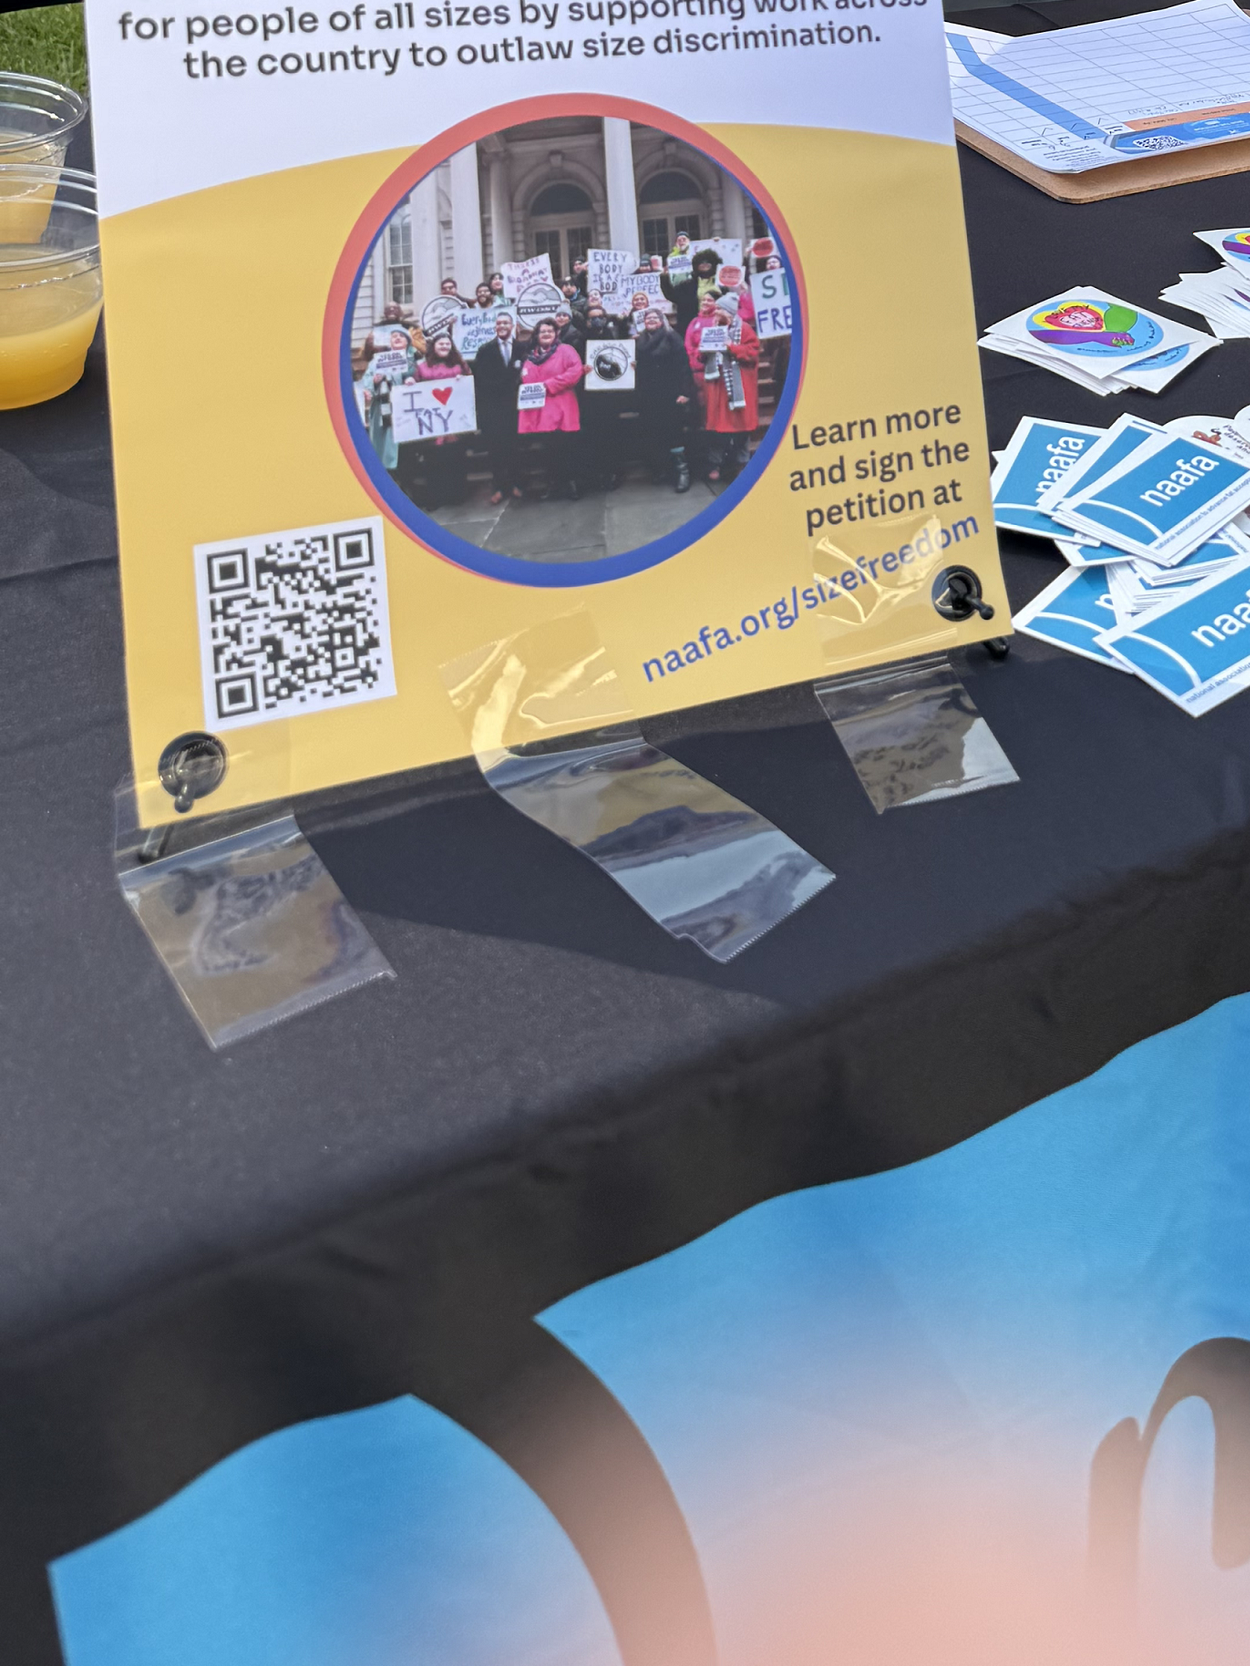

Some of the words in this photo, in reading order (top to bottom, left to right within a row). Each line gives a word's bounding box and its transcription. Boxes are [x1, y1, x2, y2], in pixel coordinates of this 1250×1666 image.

[118, 11, 175, 41] for
[186, 7, 319, 44] people
[328, 3, 367, 33] of
[375, 2, 415, 31] all
[425, 0, 511, 28] sizes
[183, 51, 247, 79] the
[257, 43, 401, 76] country
[409, 41, 448, 69] to
[456, 36, 574, 64] outlaw
[583, 31, 645, 59] size
[653, 21, 882, 55] discrimination.
[593, 251, 628, 263] EVERY
[600, 263, 623, 274] BODY
[402, 390, 423, 413] I
[417, 409, 453, 436] NY
[792, 415, 877, 451] Learn
[885, 403, 962, 436] more
[789, 455, 846, 492] and
[854, 445, 914, 484] sign
[921, 438, 970, 468] the
[1139, 455, 1220, 508] naafa
[805, 488, 925, 537] petition
[933, 478, 963, 506] at
[642, 515, 980, 683] naafa.org/sizefreedom
[1185, 683, 1216, 704] national
